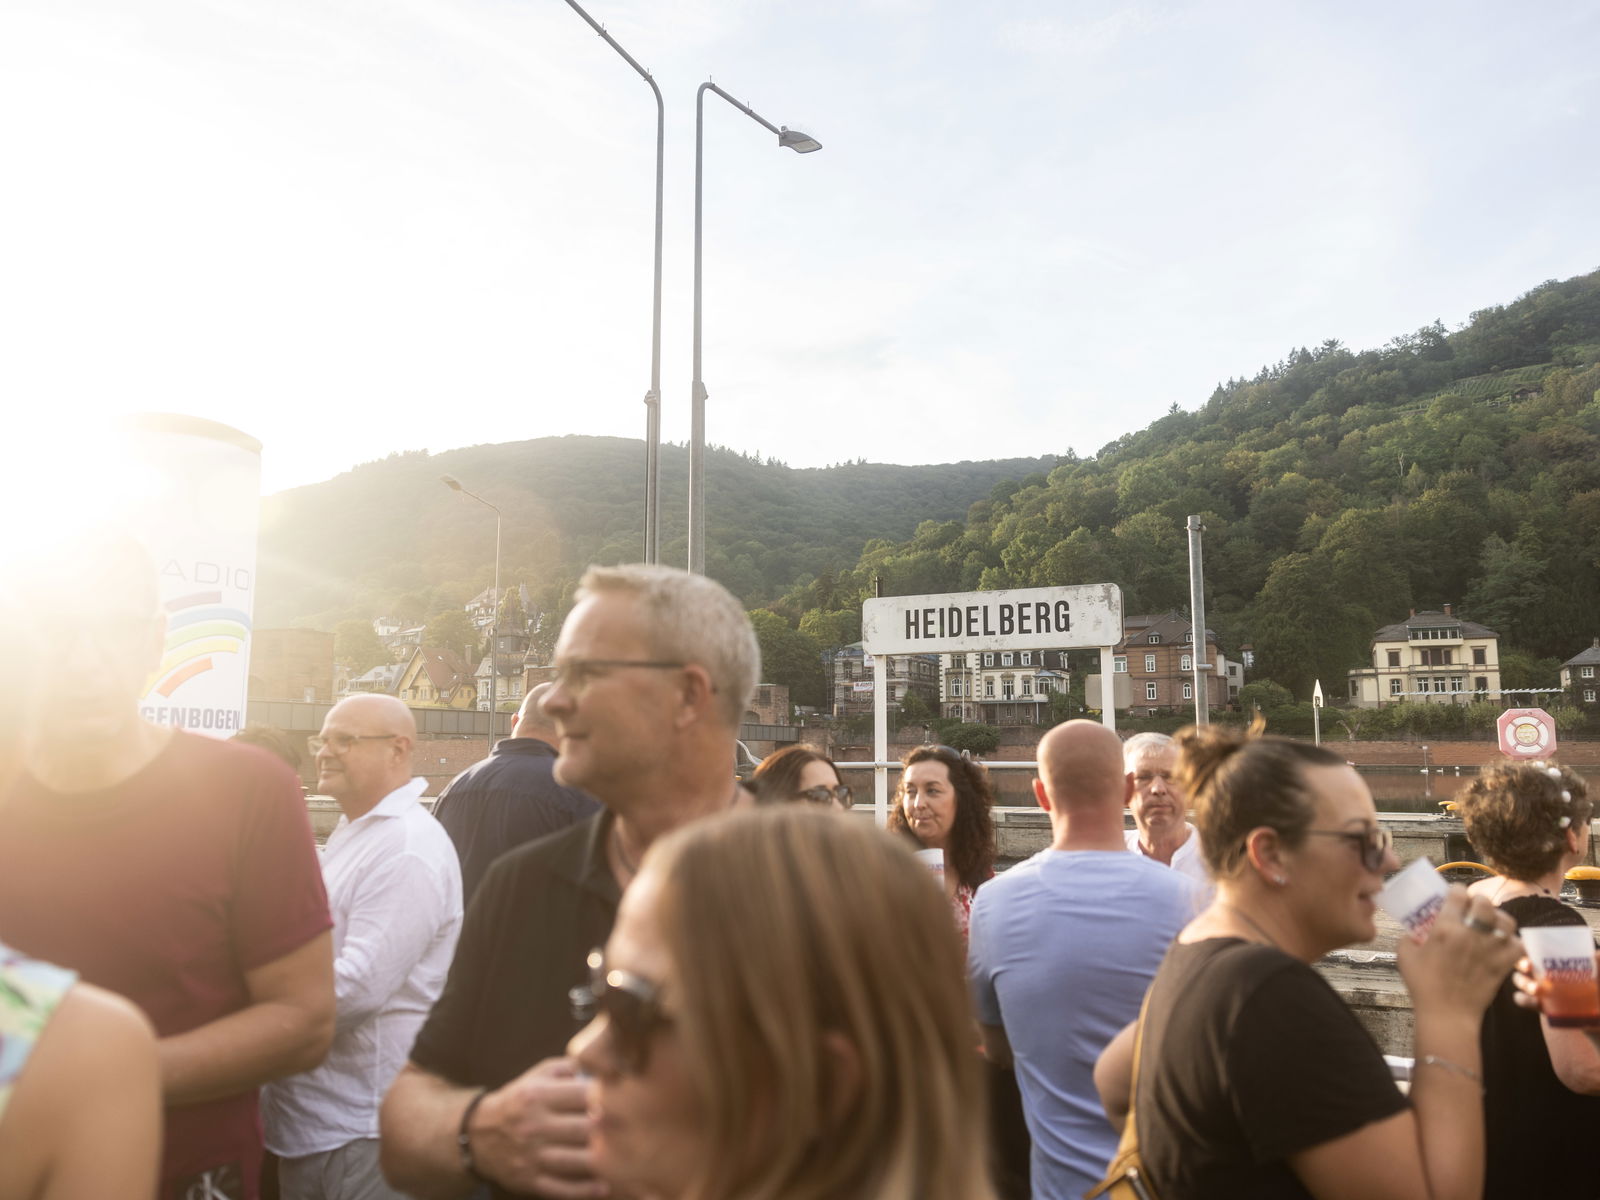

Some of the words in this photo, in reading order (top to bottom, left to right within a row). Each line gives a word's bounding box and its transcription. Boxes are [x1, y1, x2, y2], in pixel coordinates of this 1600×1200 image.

[159, 559, 249, 591] ADIO
[905, 600, 1071, 640] HEIDELBERG
[141, 707, 241, 730] GENBOGEN
